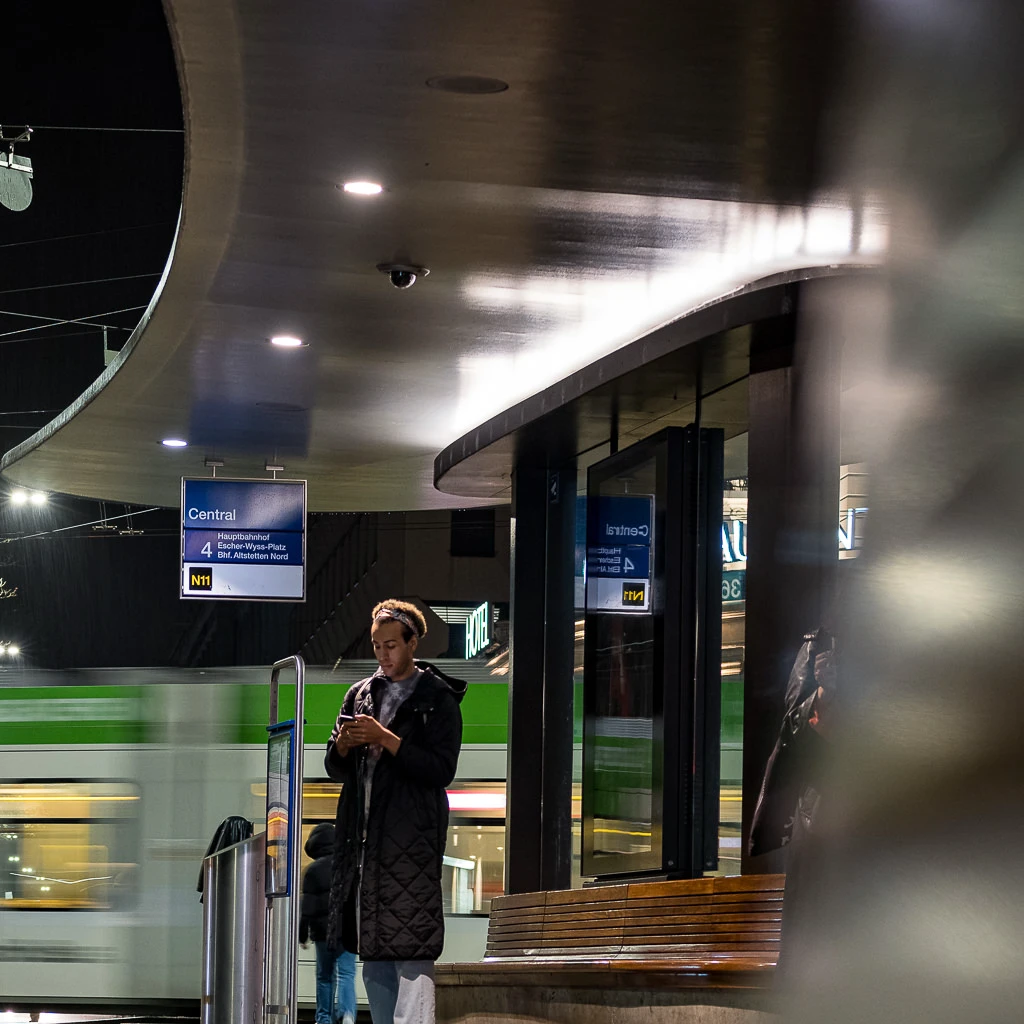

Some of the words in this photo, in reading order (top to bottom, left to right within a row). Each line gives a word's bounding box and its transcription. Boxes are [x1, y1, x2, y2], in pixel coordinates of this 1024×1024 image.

[188, 507, 236, 521] Central
[217, 532, 270, 541] Hauptbahnhof
[200, 541, 213, 558] 4
[217, 541, 287, 551] Escher-Wyss-Platz
[217, 551, 233, 559] Bhf.
[233, 552, 269, 560] Altstetten
[191, 574, 211, 586] N11
[465, 601, 490, 660] HOTEL
